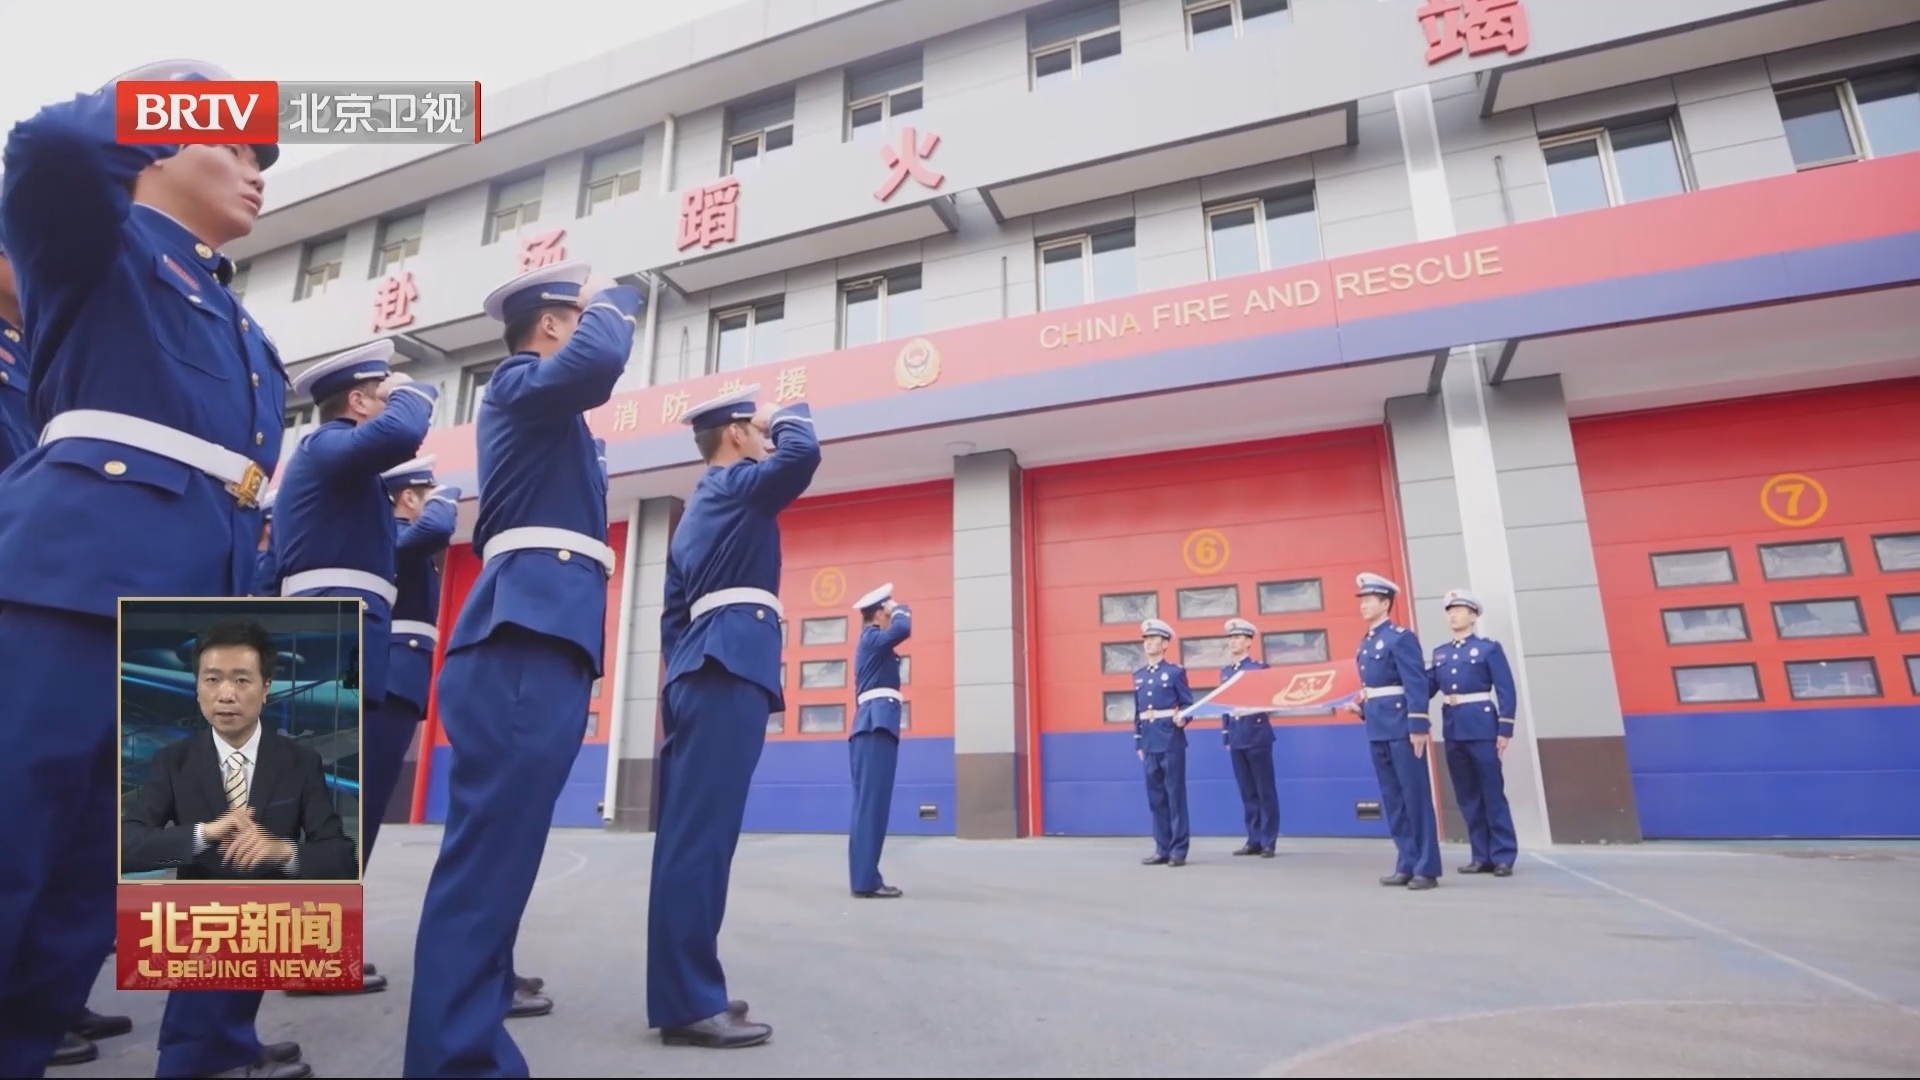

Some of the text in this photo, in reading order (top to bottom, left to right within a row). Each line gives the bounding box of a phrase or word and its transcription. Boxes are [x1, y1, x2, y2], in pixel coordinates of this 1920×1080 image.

[1038, 245, 1505, 350] CHINA FIRE AND RESCUE
